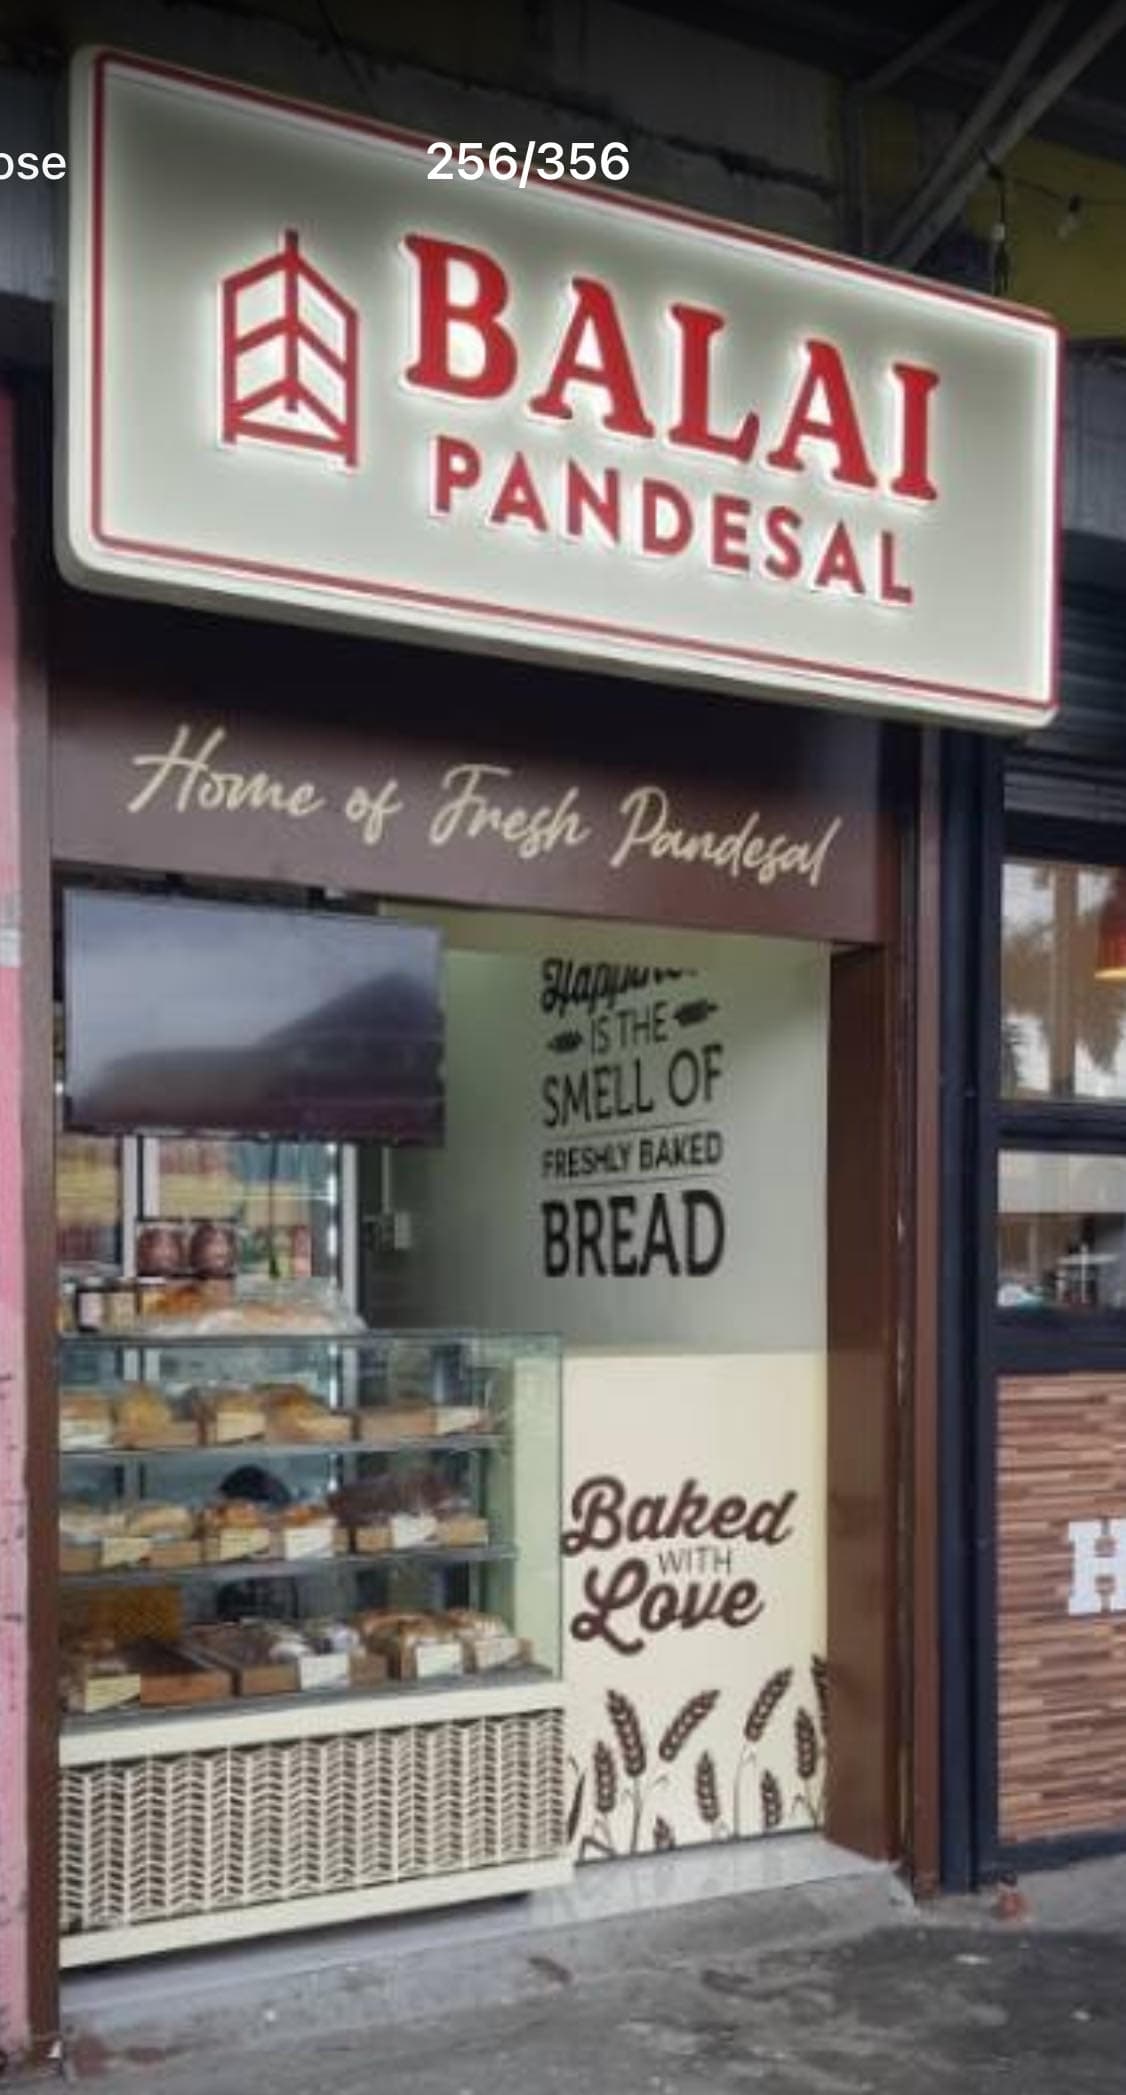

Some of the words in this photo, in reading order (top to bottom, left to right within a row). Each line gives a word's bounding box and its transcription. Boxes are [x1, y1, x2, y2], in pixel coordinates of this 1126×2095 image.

[404, 234, 940, 501] BALAI
[434, 435, 913, 602] PANDESAL
[128, 725, 325, 816] Home
[345, 780, 403, 845] of
[429, 764, 592, 859] Fresh
[610, 786, 842, 887] Pandesal
[590, 1014, 610, 1054] IS
[616, 1001, 668, 1047] THE
[541, 1057, 654, 1128] SMELL
[668, 1043, 723, 1106] OF
[541, 1141, 633, 1179] FRESHLY
[638, 1130, 724, 1171] BAKED
[540, 1189, 726, 1278] BREAD
[560, 1475, 798, 1556] Baked
[658, 1546, 732, 1576] WITH
[570, 1557, 765, 1656] Love
